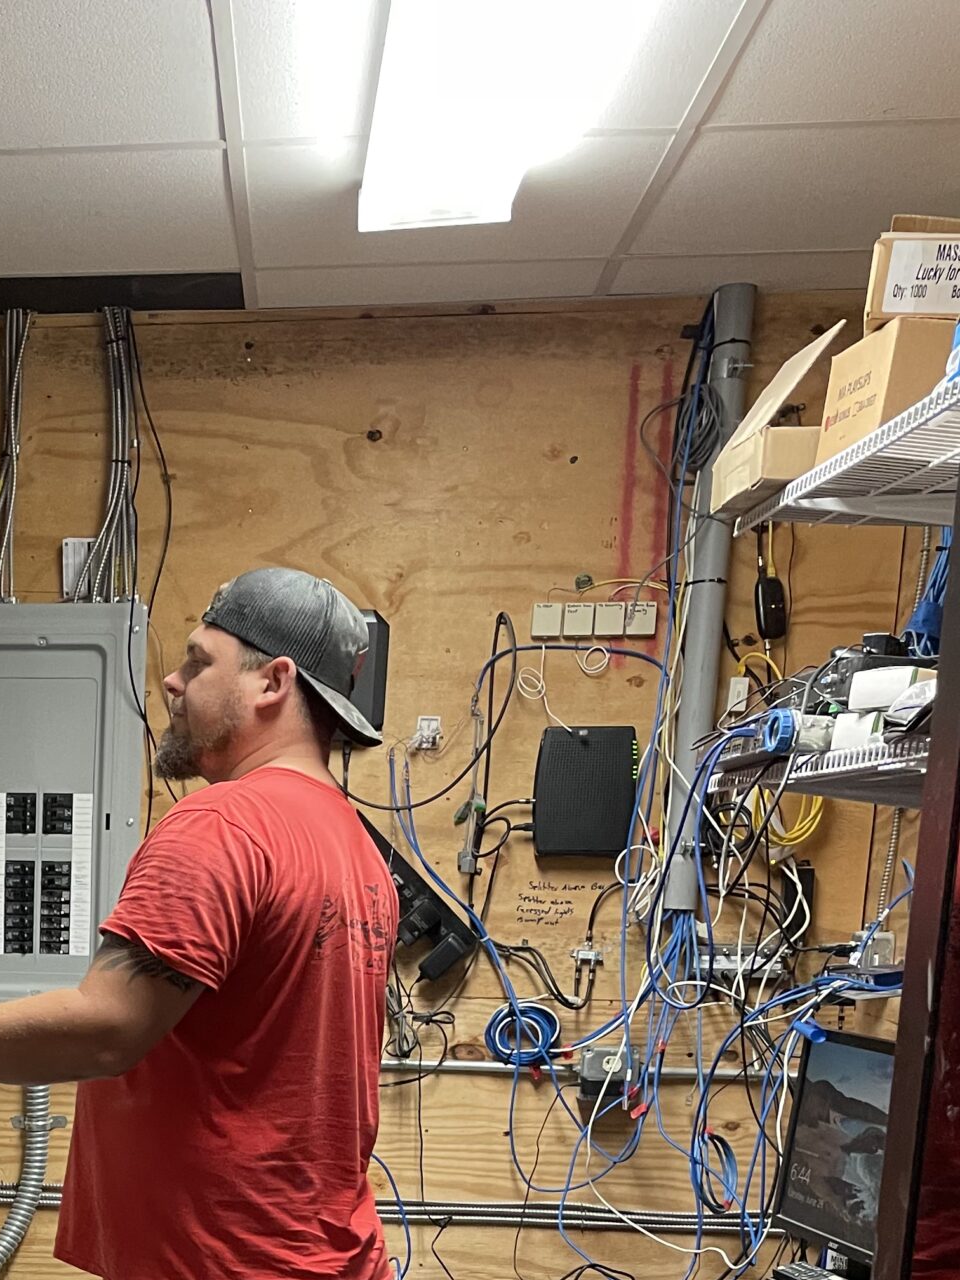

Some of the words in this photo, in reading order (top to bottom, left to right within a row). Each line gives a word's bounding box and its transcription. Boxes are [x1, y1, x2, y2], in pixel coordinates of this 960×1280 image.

[936, 244, 960, 262] MAS
[916, 263, 945, 285] Lucky
[892, 284, 908, 300] Qty:
[910, 284, 928, 299] 1000
[790, 1162, 812, 1186] 6:44
